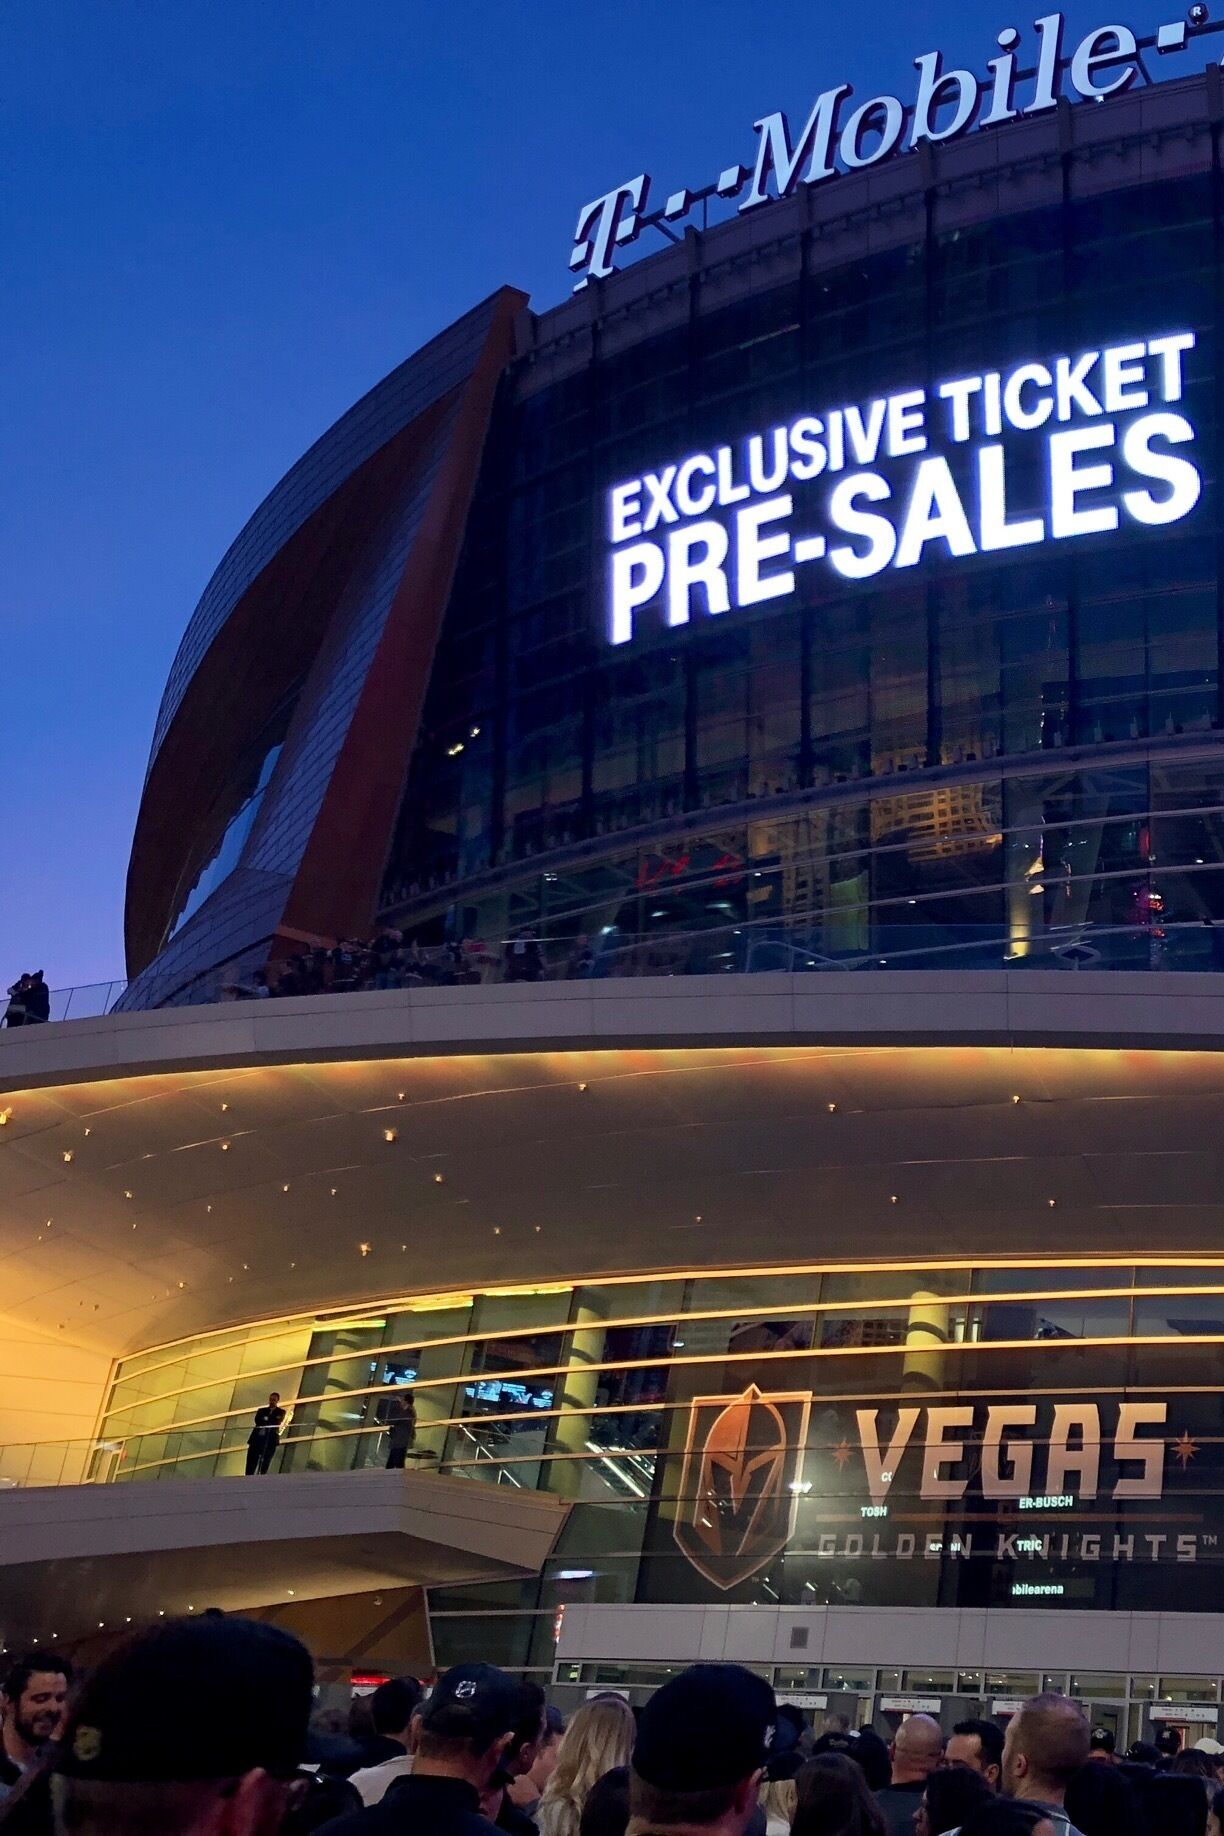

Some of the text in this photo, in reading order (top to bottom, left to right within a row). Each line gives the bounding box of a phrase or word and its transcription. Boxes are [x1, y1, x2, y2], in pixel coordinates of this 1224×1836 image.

[611, 332, 1196, 543] EXCLUSIVE TICKET
[610, 411, 1201, 646] PRE-SALES
[856, 1402, 1168, 1508] VEGAS
[817, 1533, 972, 1560] GOLDEN
[861, 1506, 888, 1517] TOSH
